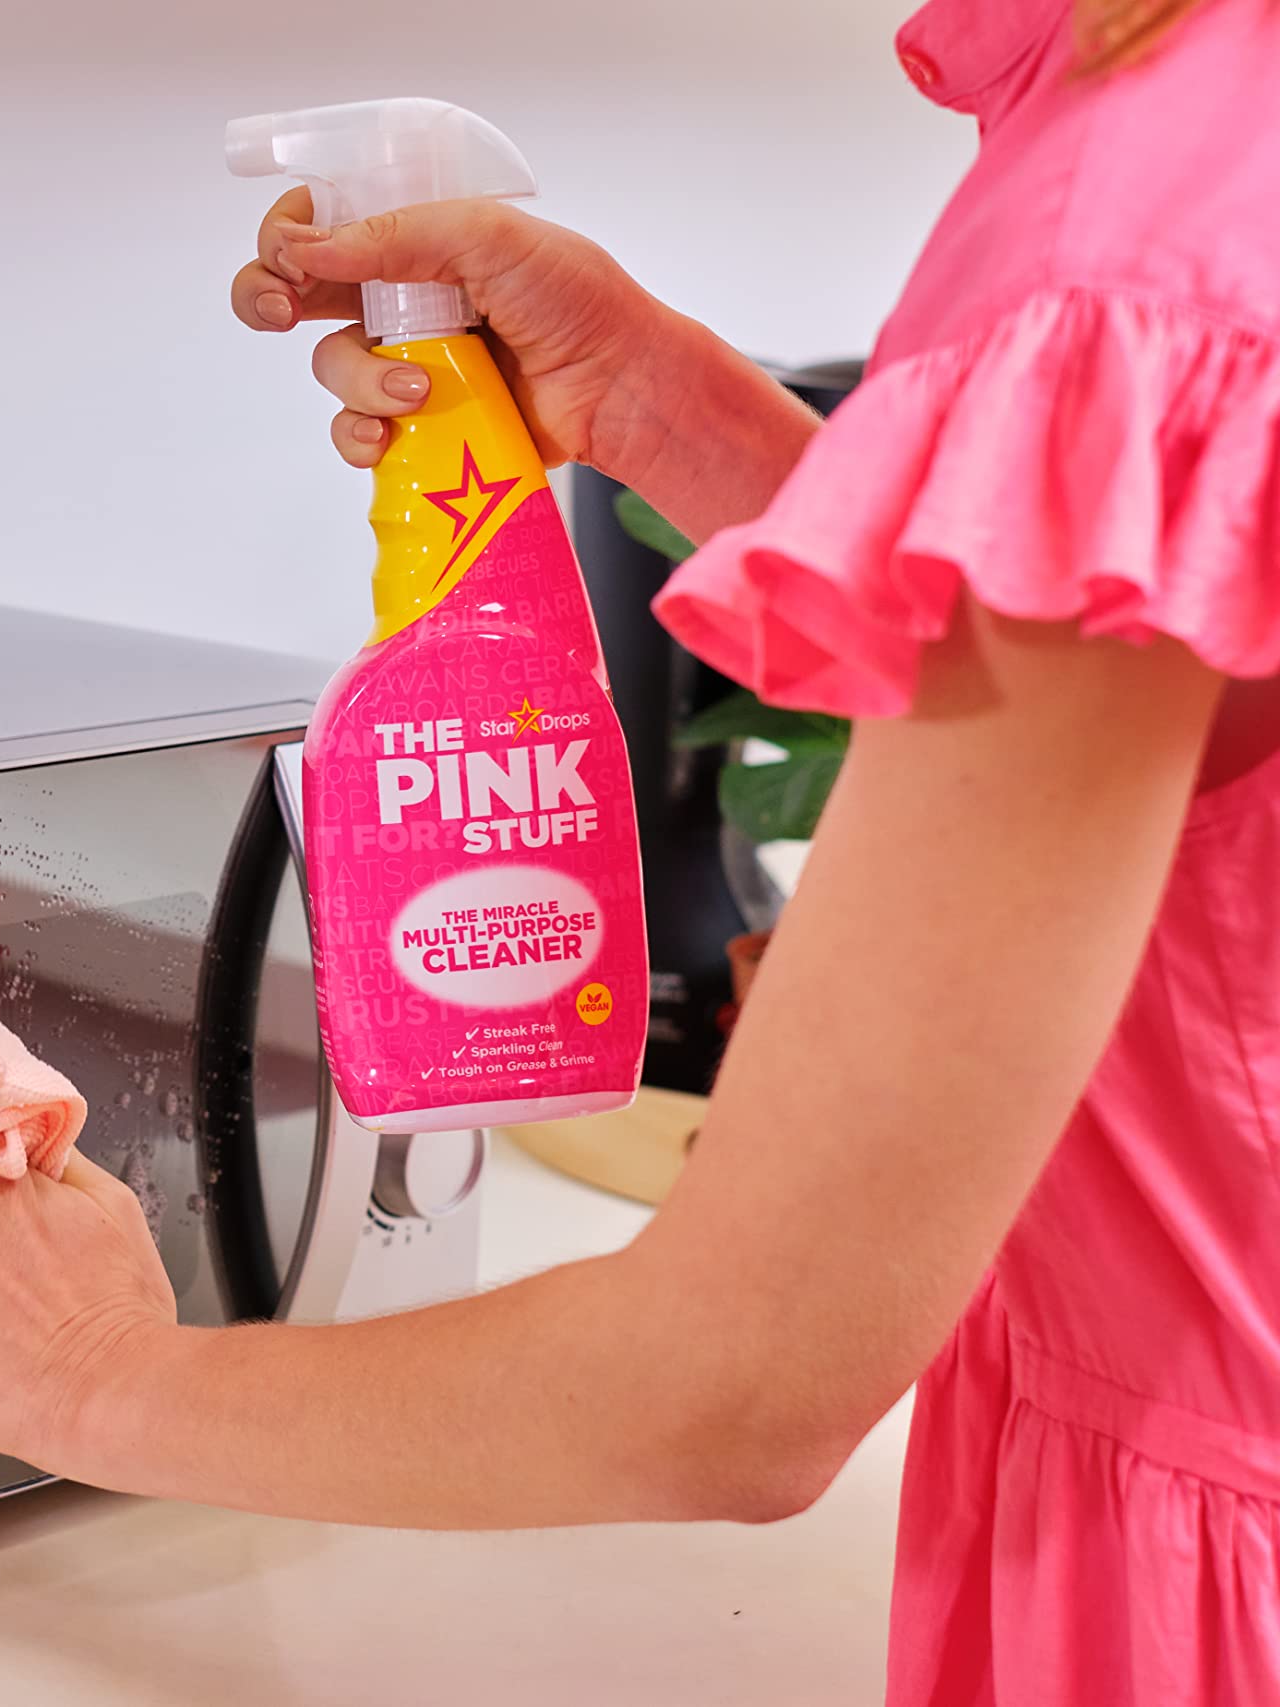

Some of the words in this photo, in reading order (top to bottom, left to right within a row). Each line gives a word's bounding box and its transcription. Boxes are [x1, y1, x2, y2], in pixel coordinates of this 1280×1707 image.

[374, 719, 464, 755] THE
[480, 720, 515, 737] Star
[541, 711, 590, 731] Drops
[376, 738, 597, 825] PINK
[462, 809, 598, 854] STUFF
[442, 911, 478, 926] THE
[483, 901, 559, 922] MIRACLE
[403, 911, 596, 949] MULTI-PURPOSE
[422, 934, 582, 975] CLEANER
[579, 1002, 610, 1013] VEGAN
[483, 1026, 528, 1040] Streak
[531, 1023, 556, 1036] Free
[471, 1043, 536, 1059] Sparkling
[538, 1040, 564, 1052] Clean
[439, 1064, 482, 1079] Tough
[486, 1063, 503, 1074] on
[507, 1059, 546, 1072] Grease
[549, 1058, 559, 1068] &
[560, 1053, 595, 1068] Grime
